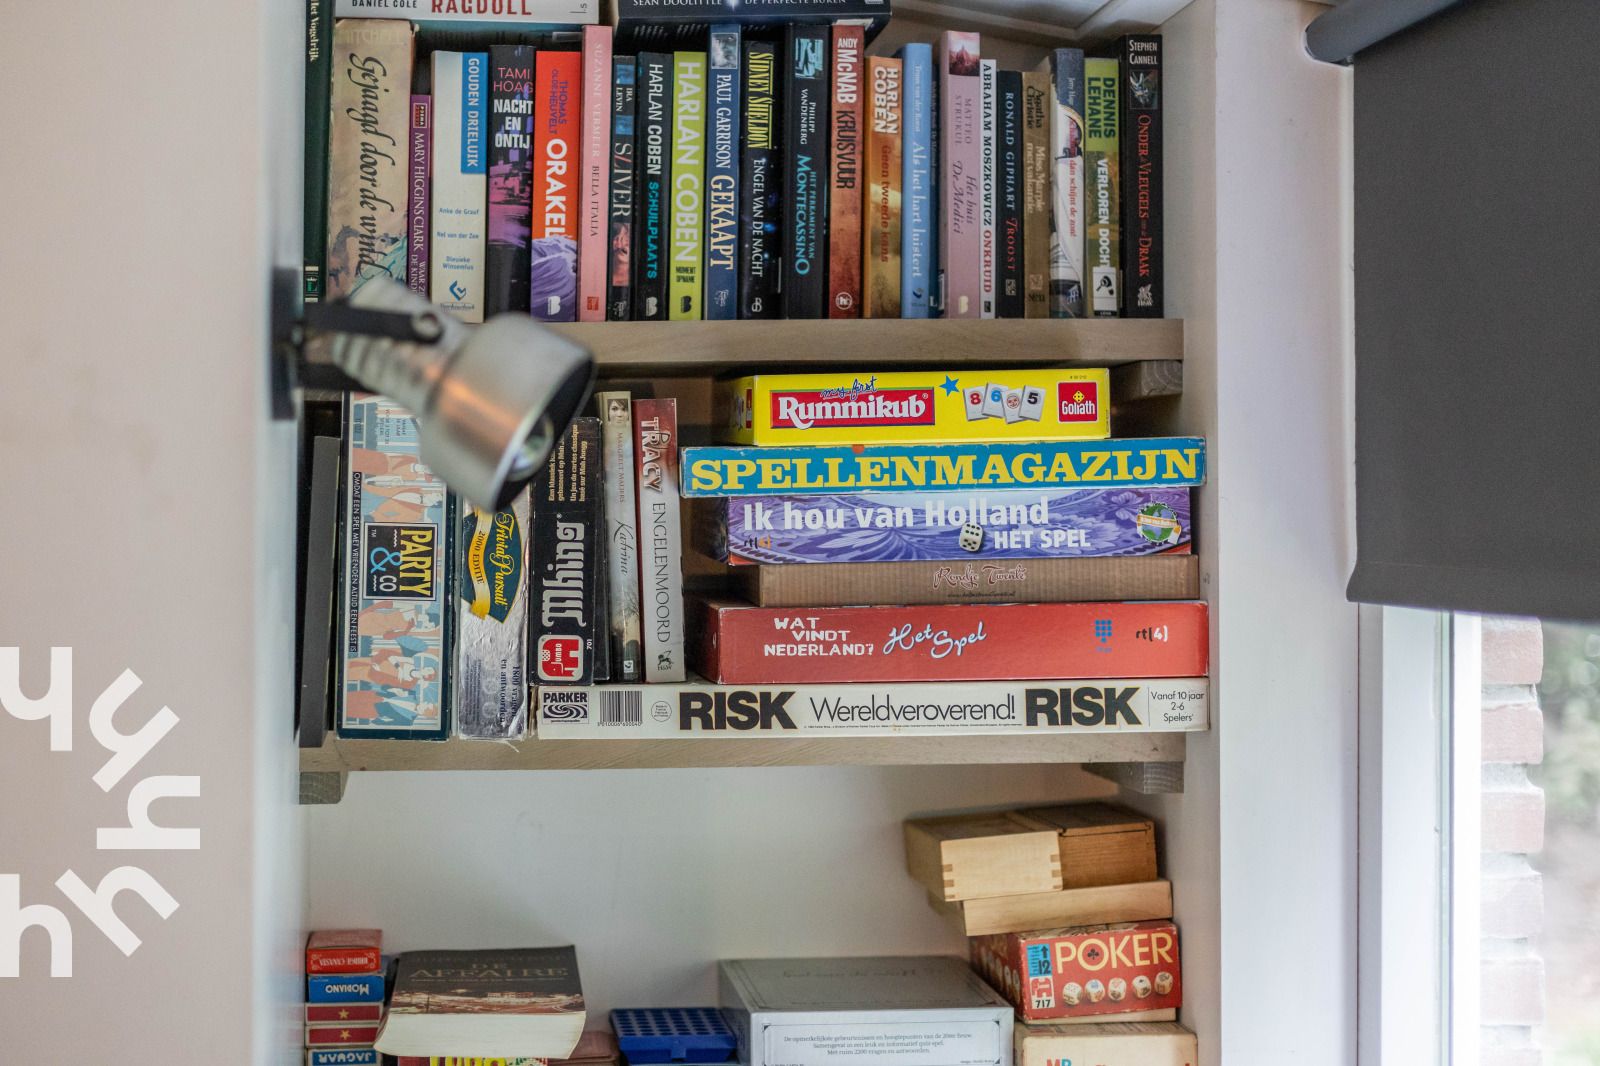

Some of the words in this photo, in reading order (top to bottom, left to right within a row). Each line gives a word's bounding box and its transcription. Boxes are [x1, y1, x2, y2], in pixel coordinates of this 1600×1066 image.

[393, 0, 417, 8] COLE
[431, 0, 532, 16] RAGDOLL
[309, 17, 320, 62] Vogelrijk
[837, 38, 858, 48] ANDY
[1128, 40, 1158, 52] STEPHEN
[498, 67, 531, 79] TAMI
[748, 52, 775, 96] SIDNEY
[1128, 53, 1158, 65] CANNELL
[346, 53, 395, 146] Gejaagd
[468, 58, 479, 106] GOUDEN
[493, 81, 534, 93] HOAG
[615, 88, 623, 112] LEVIN
[648, 64, 663, 120] HARLAN
[716, 74, 732, 104] PAUL
[874, 66, 887, 133] COBEN
[886, 66, 899, 134] HARLAN
[983, 64, 992, 131] ABRAHAM
[494, 99, 534, 114] NACHT
[558, 81, 568, 125] THOMAS
[678, 62, 702, 165] HARLAN
[800, 88, 809, 145] VANDENBERG
[964, 98, 973, 145] MATTEO
[1005, 92, 1014, 146] RONALD
[1026, 86, 1036, 129] Christie
[1088, 77, 1102, 139] LEHANE
[1103, 77, 1116, 139] DENNIS
[467, 111, 478, 167] DRIELUIK
[495, 133, 530, 149] ONTIJ
[505, 117, 521, 131] EN
[592, 103, 602, 157] VERMEER
[715, 107, 732, 168] GARRISON
[747, 97, 774, 150] SHELDON
[1138, 114, 1152, 156] ONDER
[359, 142, 395, 187] door
[414, 133, 425, 162] MARY
[647, 125, 662, 174] COBEN
[836, 110, 856, 189] KRUISVUUR
[912, 141, 928, 165] Als
[414, 166, 425, 215] HIGGINS
[545, 138, 568, 238] ORAKEL
[591, 165, 600, 197] BELLA
[612, 143, 632, 217] SLIVER
[753, 159, 766, 194] ENGEL
[912, 169, 927, 190] het
[983, 136, 993, 226] MOSZKOWICZ
[1005, 151, 1016, 210] GIPHART
[1097, 159, 1110, 224] VERLOREN
[1138, 162, 1152, 218] VLEUGELS
[359, 188, 394, 212] de
[675, 173, 698, 261] COBEN
[752, 196, 764, 218] VAN
[795, 154, 812, 275] MONTECASSINO
[881, 182, 892, 229] tweede
[911, 195, 927, 224] hart
[952, 182, 965, 235] Medici
[413, 217, 424, 251] CLARK
[590, 202, 599, 237] ITALIA
[647, 182, 659, 279] SCHUILPLAATS
[710, 174, 736, 270] GEKAAPT
[752, 221, 763, 235] DE
[356, 215, 393, 278] wind
[751, 239, 763, 277] NACHT
[911, 228, 927, 278] luistert
[983, 230, 992, 293] ONKRUID
[1006, 218, 1018, 272] TROOST
[1138, 238, 1152, 277] DRAAK
[778, 393, 926, 430] Rummikub
[991, 390, 1000, 402] 6
[1027, 392, 1039, 405] 5
[1062, 400, 1096, 415] Goliath
[571, 424, 579, 452] classique
[640, 416, 662, 493] TRACY
[353, 472, 361, 497] OMDAT
[557, 469, 565, 501] gebaseerd
[691, 448, 1200, 491] SPELLENMAGAZIJN
[352, 515, 360, 532] SPEL
[353, 498, 361, 515] EEN
[743, 501, 774, 531] Ik
[784, 500, 845, 530] hou
[855, 507, 914, 529] van
[925, 496, 1049, 527] Holland
[475, 530, 486, 552] 2000
[495, 511, 515, 559] Trivial
[614, 519, 635, 577] Katrina
[994, 530, 1034, 549] HET
[1040, 529, 1091, 549] SPEL
[351, 547, 359, 584] VRIENDEN
[399, 529, 433, 596] PARTY
[472, 554, 485, 585] EDITIE
[490, 553, 514, 606] Pursuit
[541, 520, 587, 628] Mhing
[652, 502, 671, 643] ENGELENMOORD
[379, 575, 397, 592] CO
[350, 610, 358, 624] EEN
[350, 625, 358, 645] FEEST
[773, 617, 821, 630] WAT
[791, 630, 850, 642] VINDT
[550, 642, 563, 675] JUMBO
[763, 643, 875, 657] NEDERLAND?
[882, 623, 934, 656] Het
[930, 621, 988, 659] Spel
[512, 666, 521, 686] 1800
[543, 691, 588, 703] PARKER
[679, 690, 798, 731] RISK
[809, 692, 1016, 722] Wereldveroverend!
[1024, 687, 1143, 727] RISK
[1150, 690, 1176, 700] Vanaf
[1178, 691, 1187, 700] 10
[1188, 691, 1205, 701] jaar
[1171, 701, 1185, 711] 2-6
[1038, 959, 1052, 975] 12
[1055, 932, 1173, 974] POKER
[325, 983, 369, 996] MODIANO
[409, 968, 569, 978] AFFAIRE
[1035, 999, 1051, 1009] 717
[318, 1052, 372, 1064] JAGUAR
